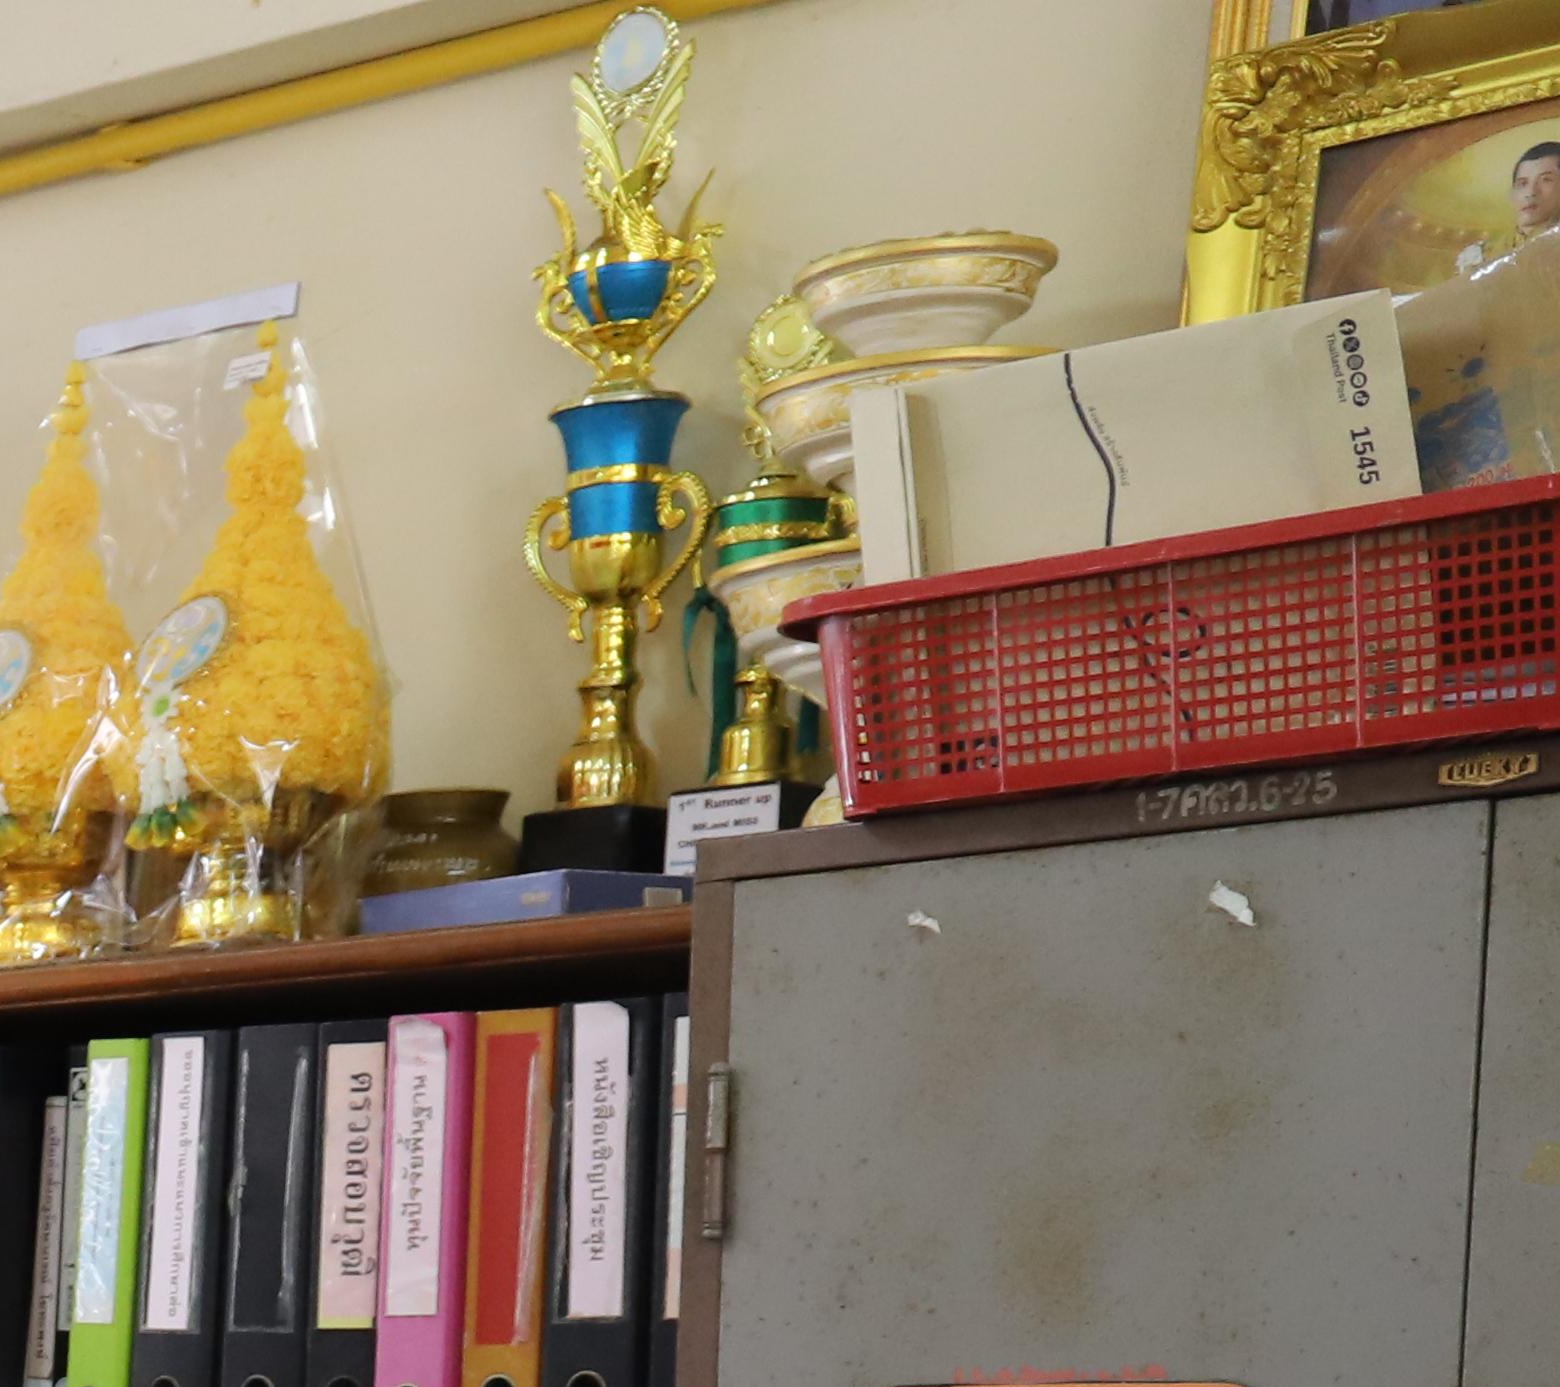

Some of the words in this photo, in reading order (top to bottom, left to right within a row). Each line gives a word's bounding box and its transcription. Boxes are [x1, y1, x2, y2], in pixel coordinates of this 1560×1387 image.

[1325, 333, 1346, 377] Thailand
[1336, 380, 1347, 403] Post
[1349, 427, 1380, 485] 1545
[704, 797, 752, 808] Runner
[756, 794, 772, 806] up
[330, 1073, 377, 1277] ตรวจสอบวุฒิ
[397, 1075, 433, 1250] ทุนปัจจัยพื้นฐาน
[582, 1057, 616, 1262] หนังสือเชิญประชุม
